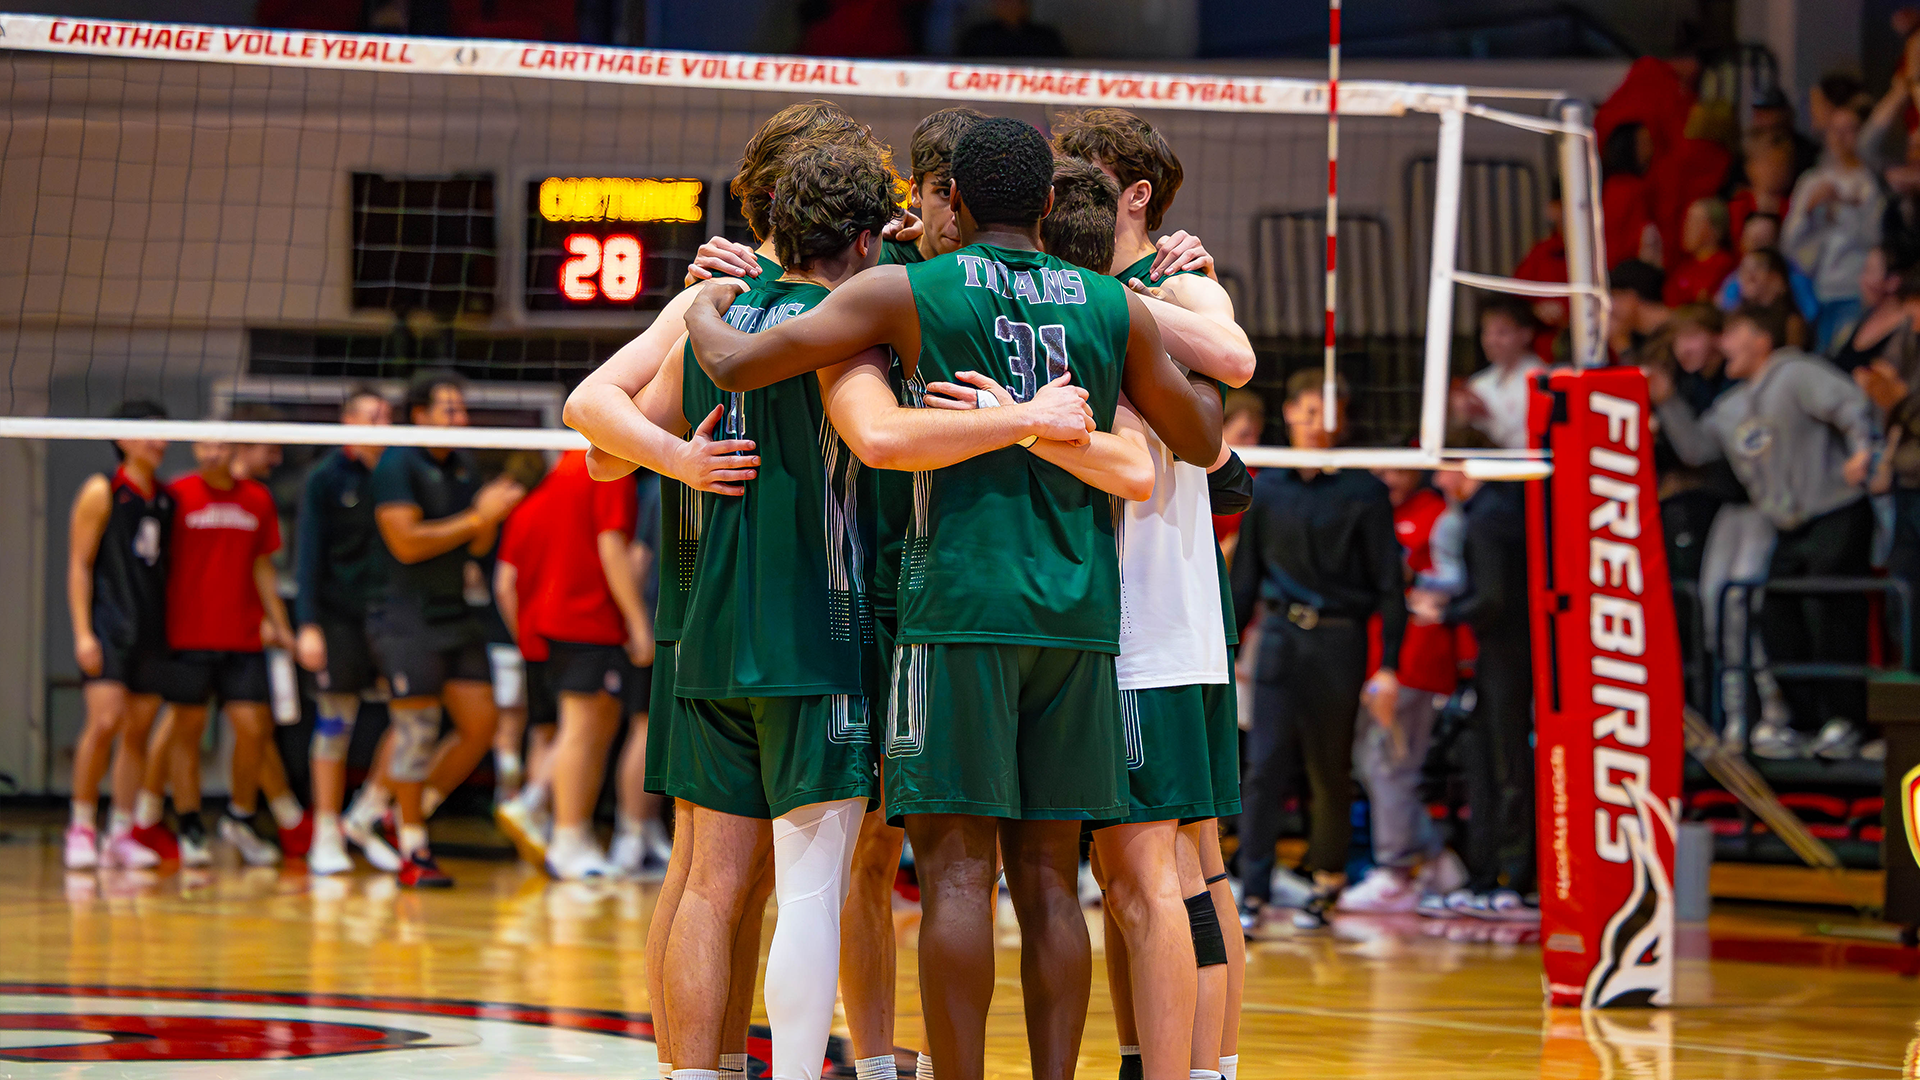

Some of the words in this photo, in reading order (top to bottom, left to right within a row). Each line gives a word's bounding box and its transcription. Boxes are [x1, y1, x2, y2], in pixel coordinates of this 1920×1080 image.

[49, 20, 214, 52] CARTHAGE
[223, 31, 414, 64] VOLLEYBALL
[520, 48, 672, 76] CARTHAGE
[682, 57, 859, 86] VOLLEYBALL
[948, 71, 1091, 96] CARTHAGE
[1099, 78, 1267, 104] VOLLEYBALL
[559, 233, 643, 301] 28
[957, 254, 1087, 305] TITANS
[995, 315, 1068, 404] 31
[1589, 390, 1652, 864] FIREBIRDS
